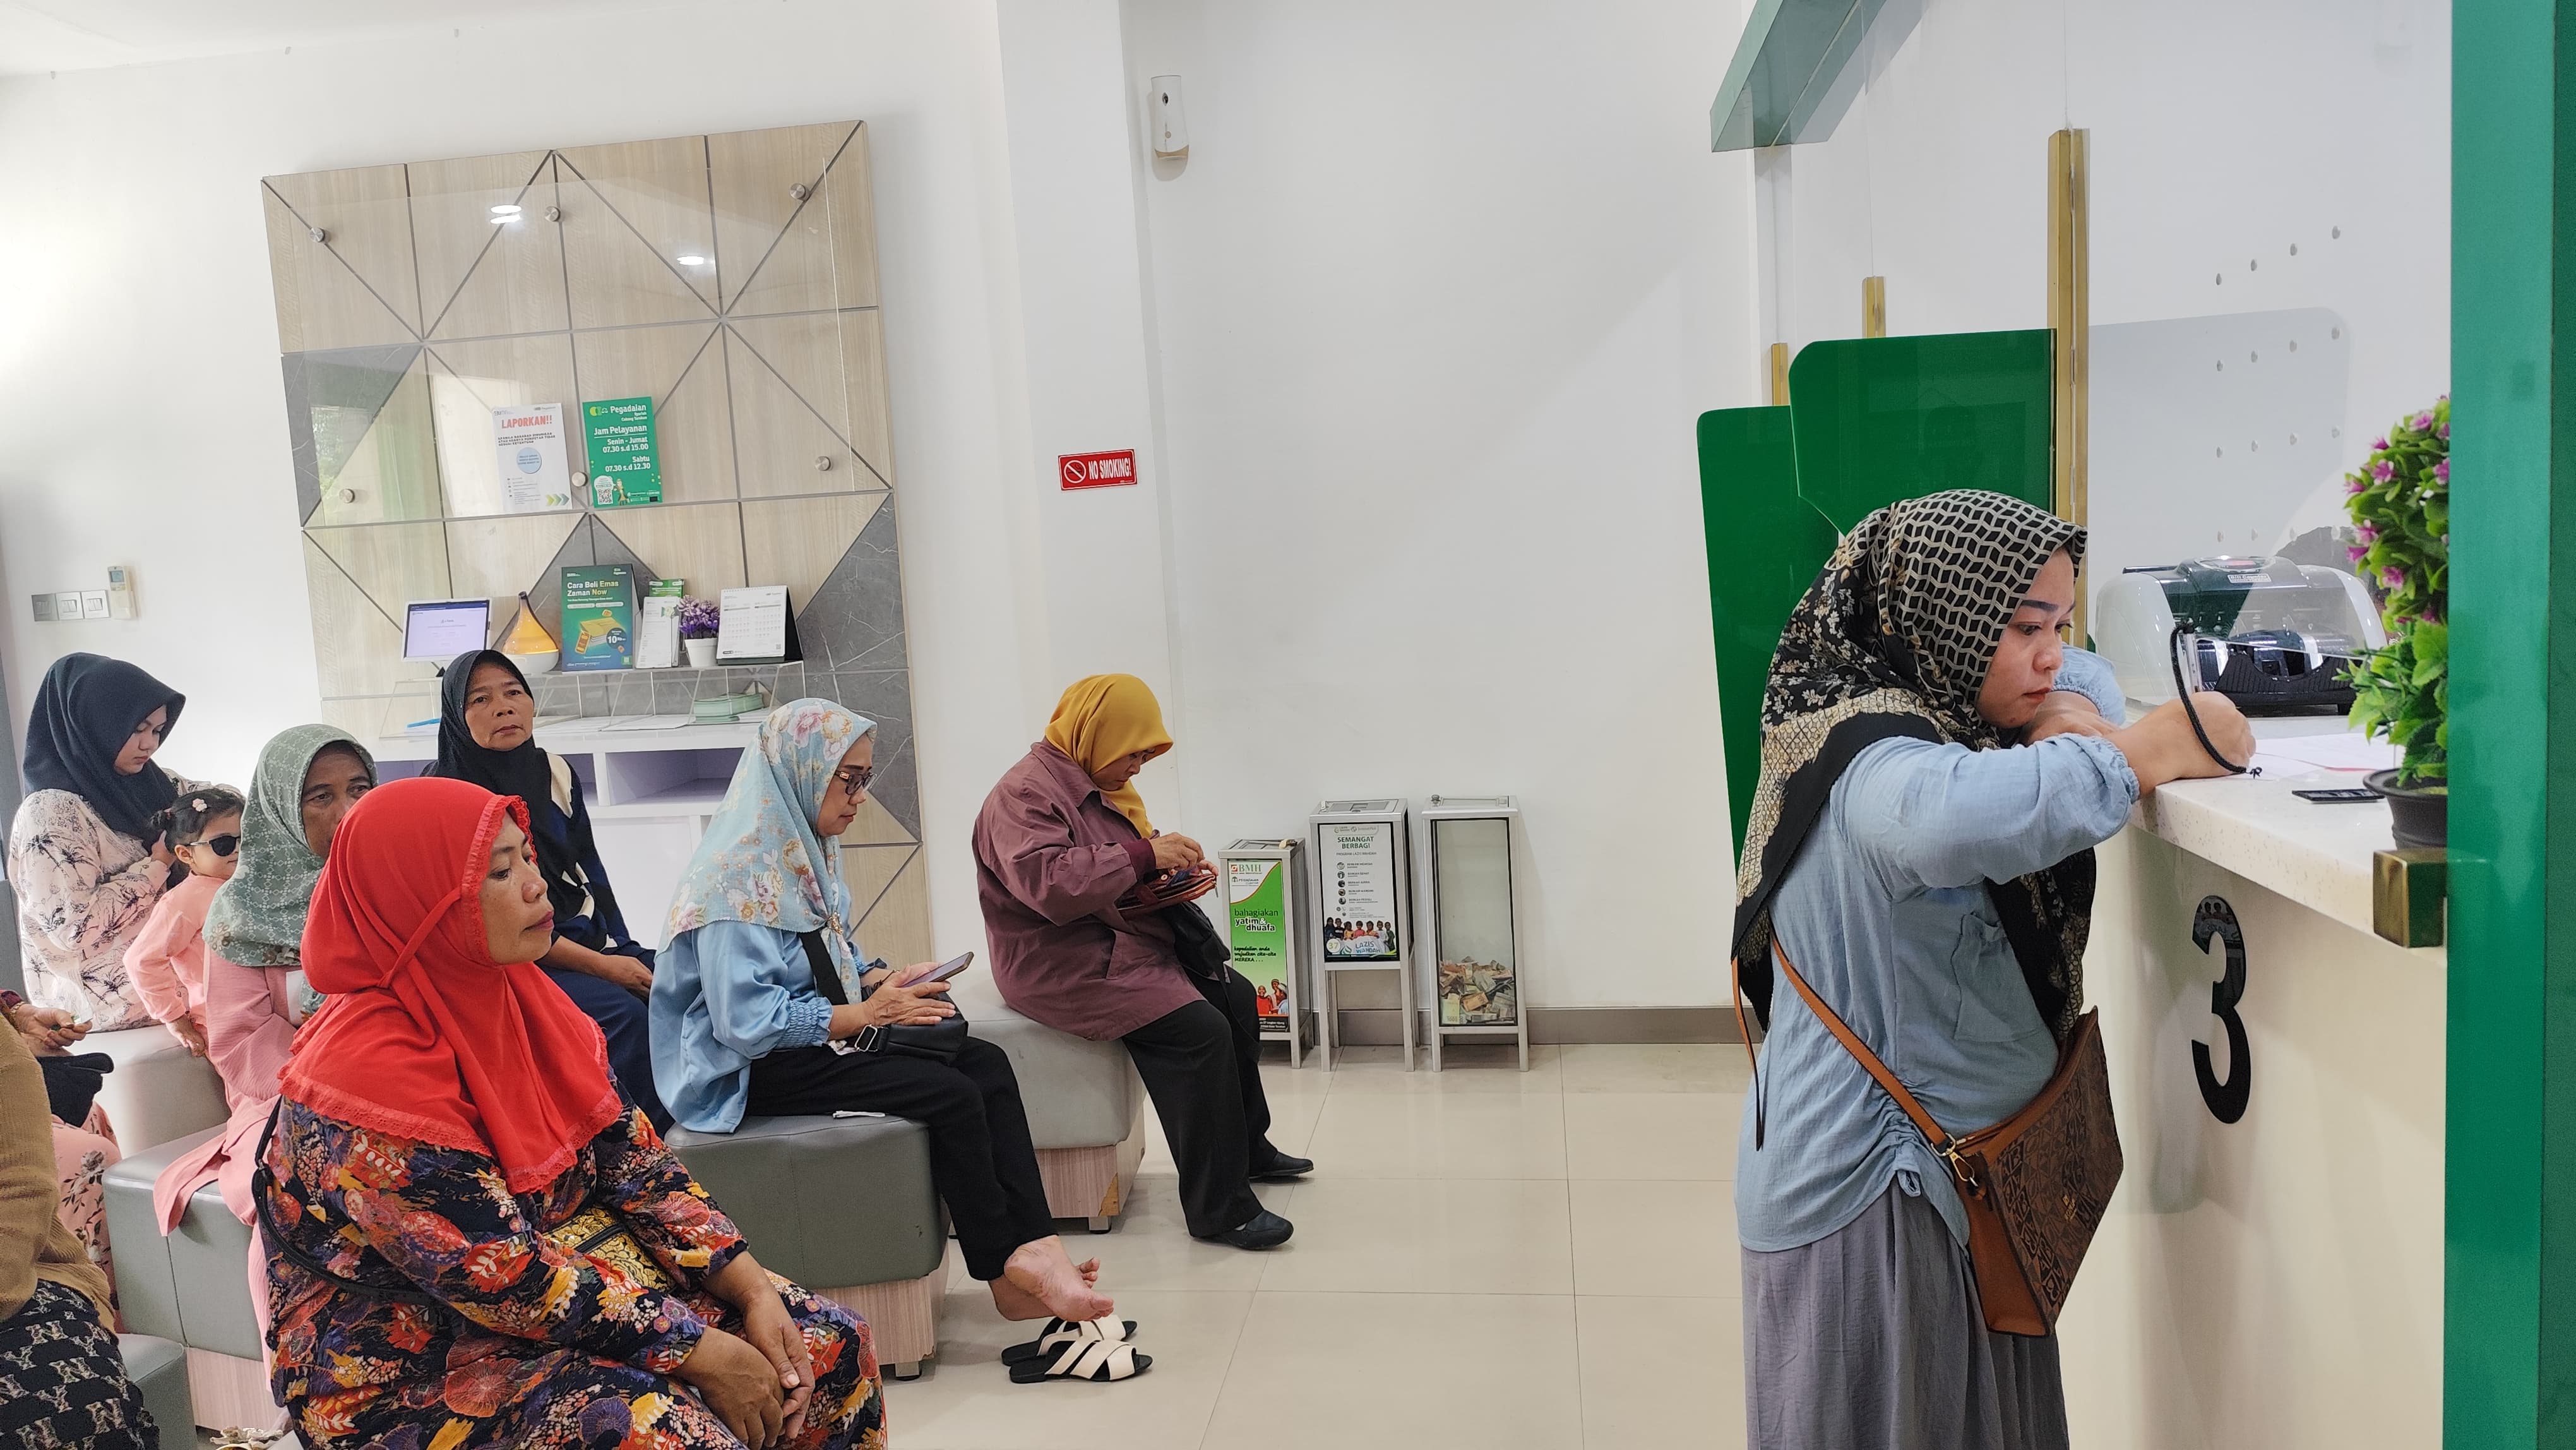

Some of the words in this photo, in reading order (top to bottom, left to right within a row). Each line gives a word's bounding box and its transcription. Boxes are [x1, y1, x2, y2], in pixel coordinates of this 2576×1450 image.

[501, 415, 552, 429] LAPORKAN!!
[594, 428, 609, 436] Jam
[609, 425, 647, 434] Pelayanan
[1088, 460, 1099, 480] NO
[1099, 457, 1132, 479] SMOKING!
[607, 635, 617, 644] 10
[1239, 864, 1261, 872] BMH
[1234, 908, 1279, 918] bahagiakan
[1235, 917, 1259, 926] yatim
[1246, 923, 1275, 932] dhuafa
[1355, 940, 1374, 949] LAZIS
[2191, 895, 2251, 1124] 3
